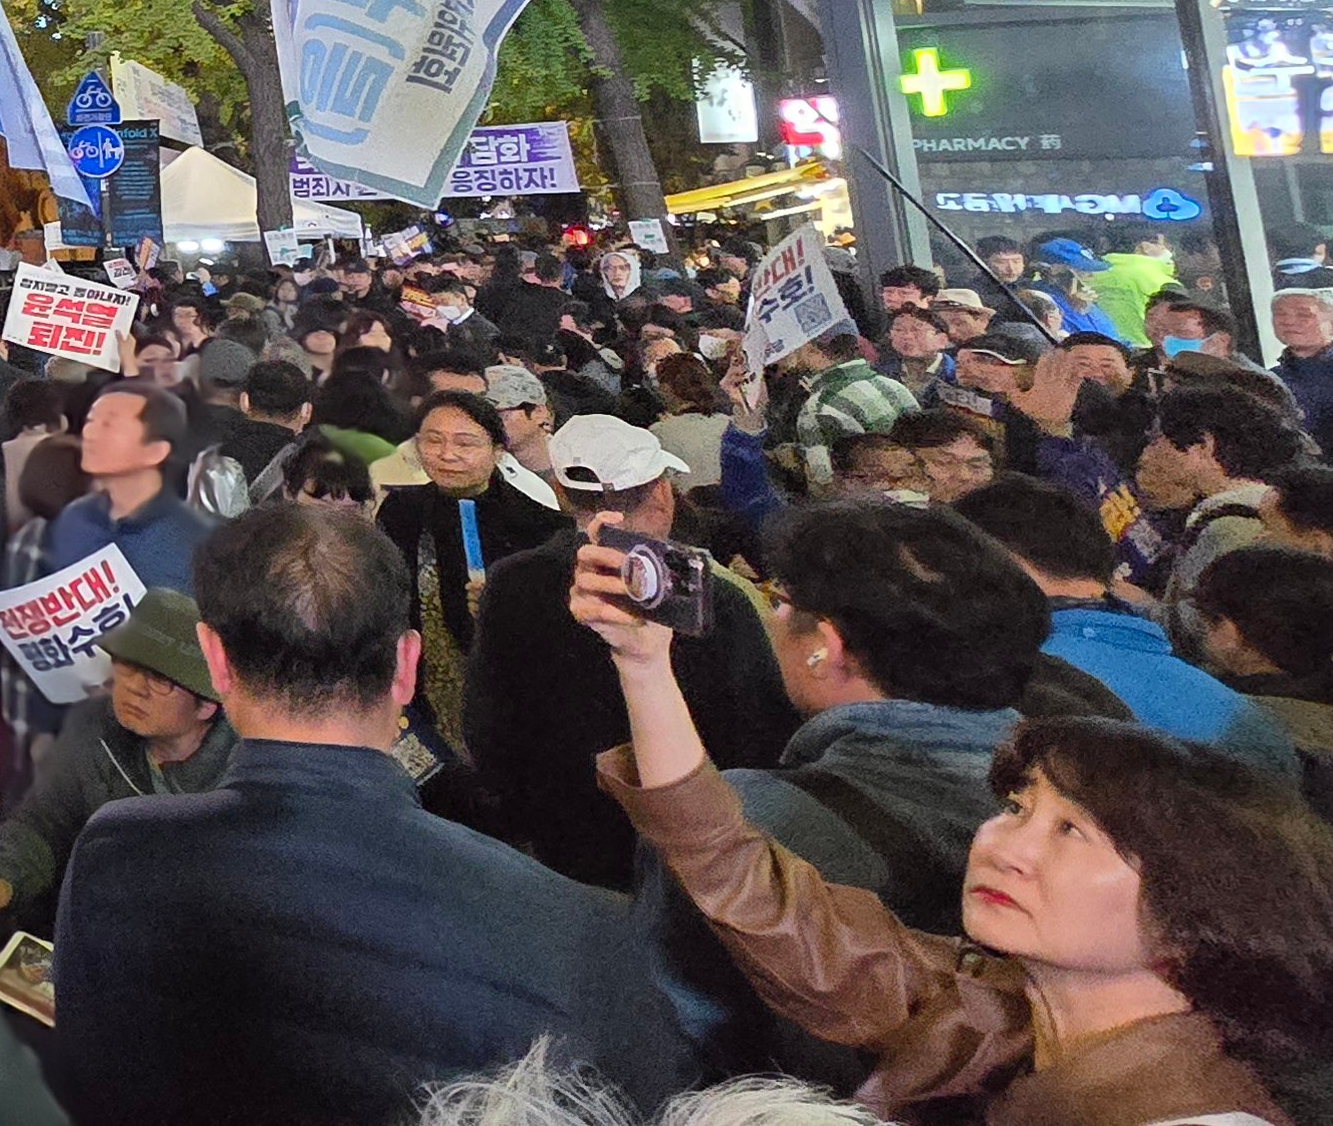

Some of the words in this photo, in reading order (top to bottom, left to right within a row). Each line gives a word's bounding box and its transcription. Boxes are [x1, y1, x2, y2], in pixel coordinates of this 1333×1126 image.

[116, 128, 147, 139] nfold
[912, 136, 1029, 152] PHARMACY
[451, 167, 559, 193] 응징하자!
[21, 292, 119, 330] 윤석열
[27, 321, 107, 356] 퇴진!
